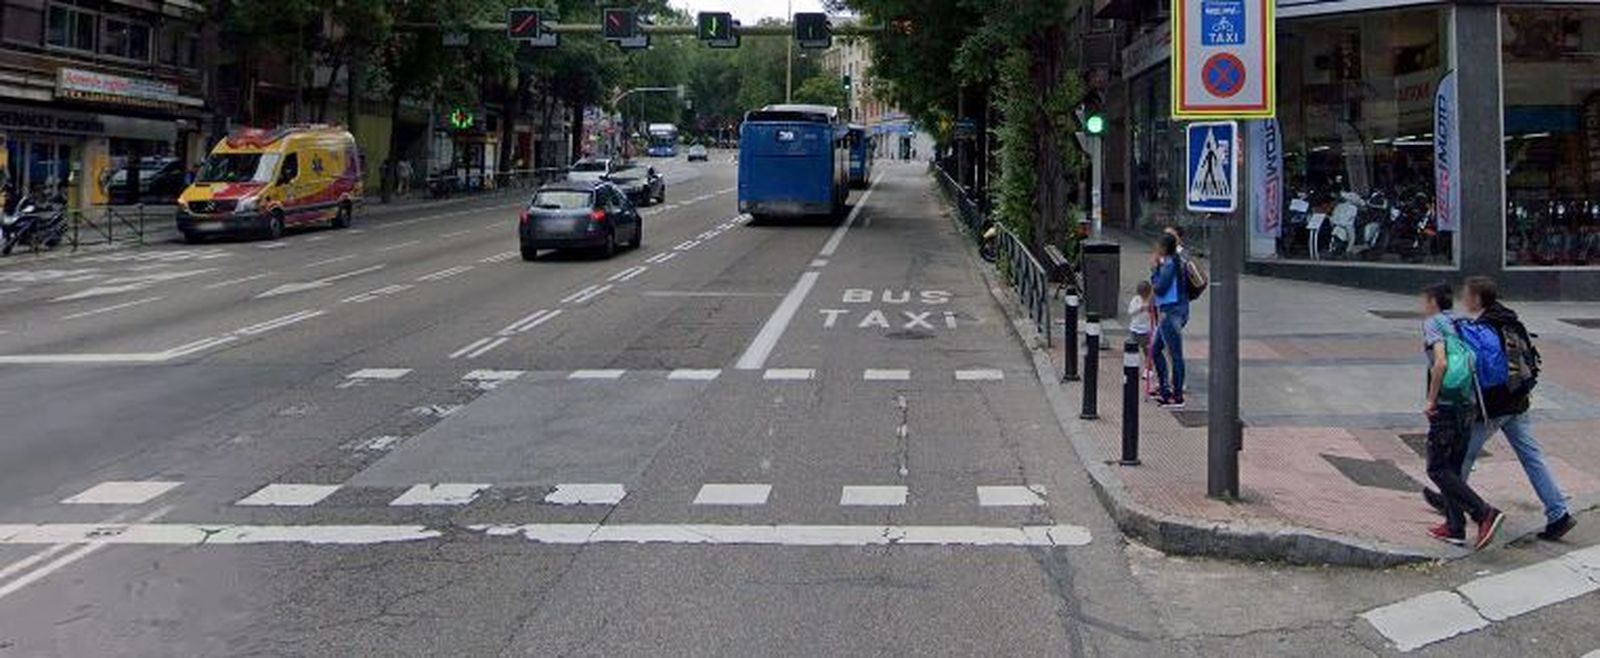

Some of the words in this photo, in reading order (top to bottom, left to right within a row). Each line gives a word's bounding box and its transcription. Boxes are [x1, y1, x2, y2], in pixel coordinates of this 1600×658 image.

[1208, 33, 1238, 43] TAXI
[842, 288, 952, 304] BUS
[819, 309, 957, 329] TAXI
